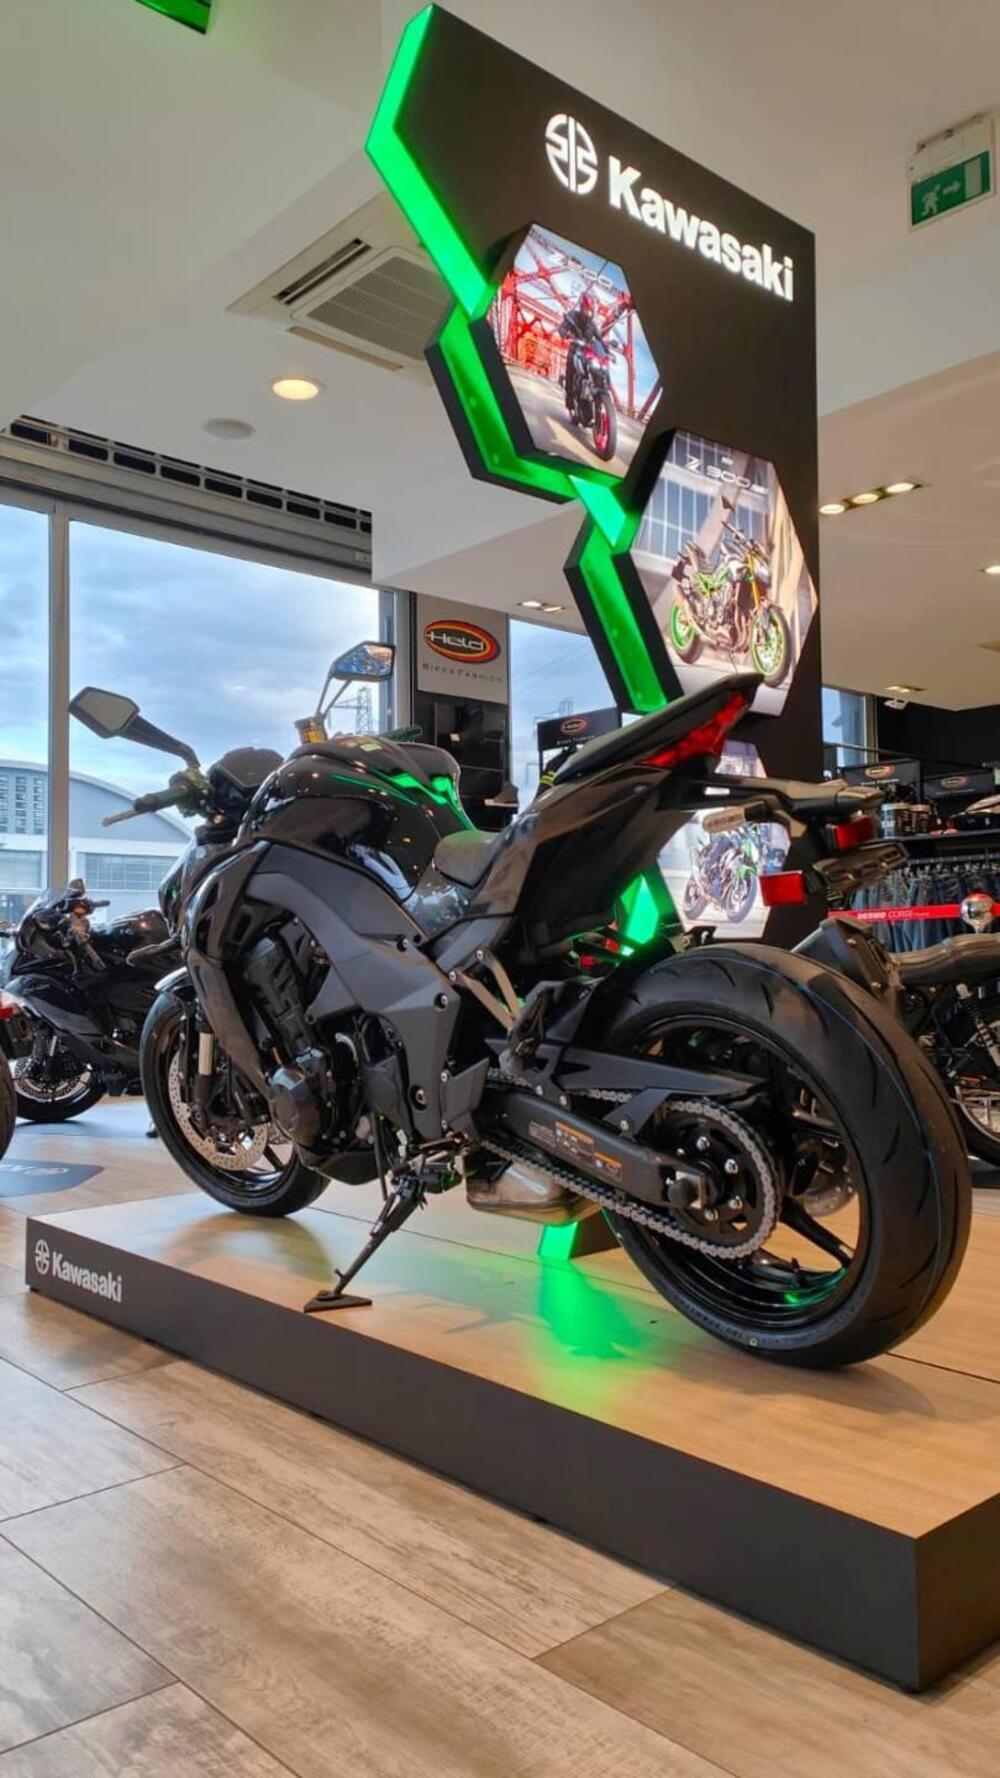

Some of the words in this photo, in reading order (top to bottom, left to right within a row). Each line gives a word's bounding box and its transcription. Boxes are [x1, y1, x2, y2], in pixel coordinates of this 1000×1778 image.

[608, 154, 794, 301] Kawasaki
[686, 454, 702, 474] Z
[706, 464, 751, 489] 900
[425, 631, 485, 652] Held
[52, 1251, 122, 1303] Kawasaki
